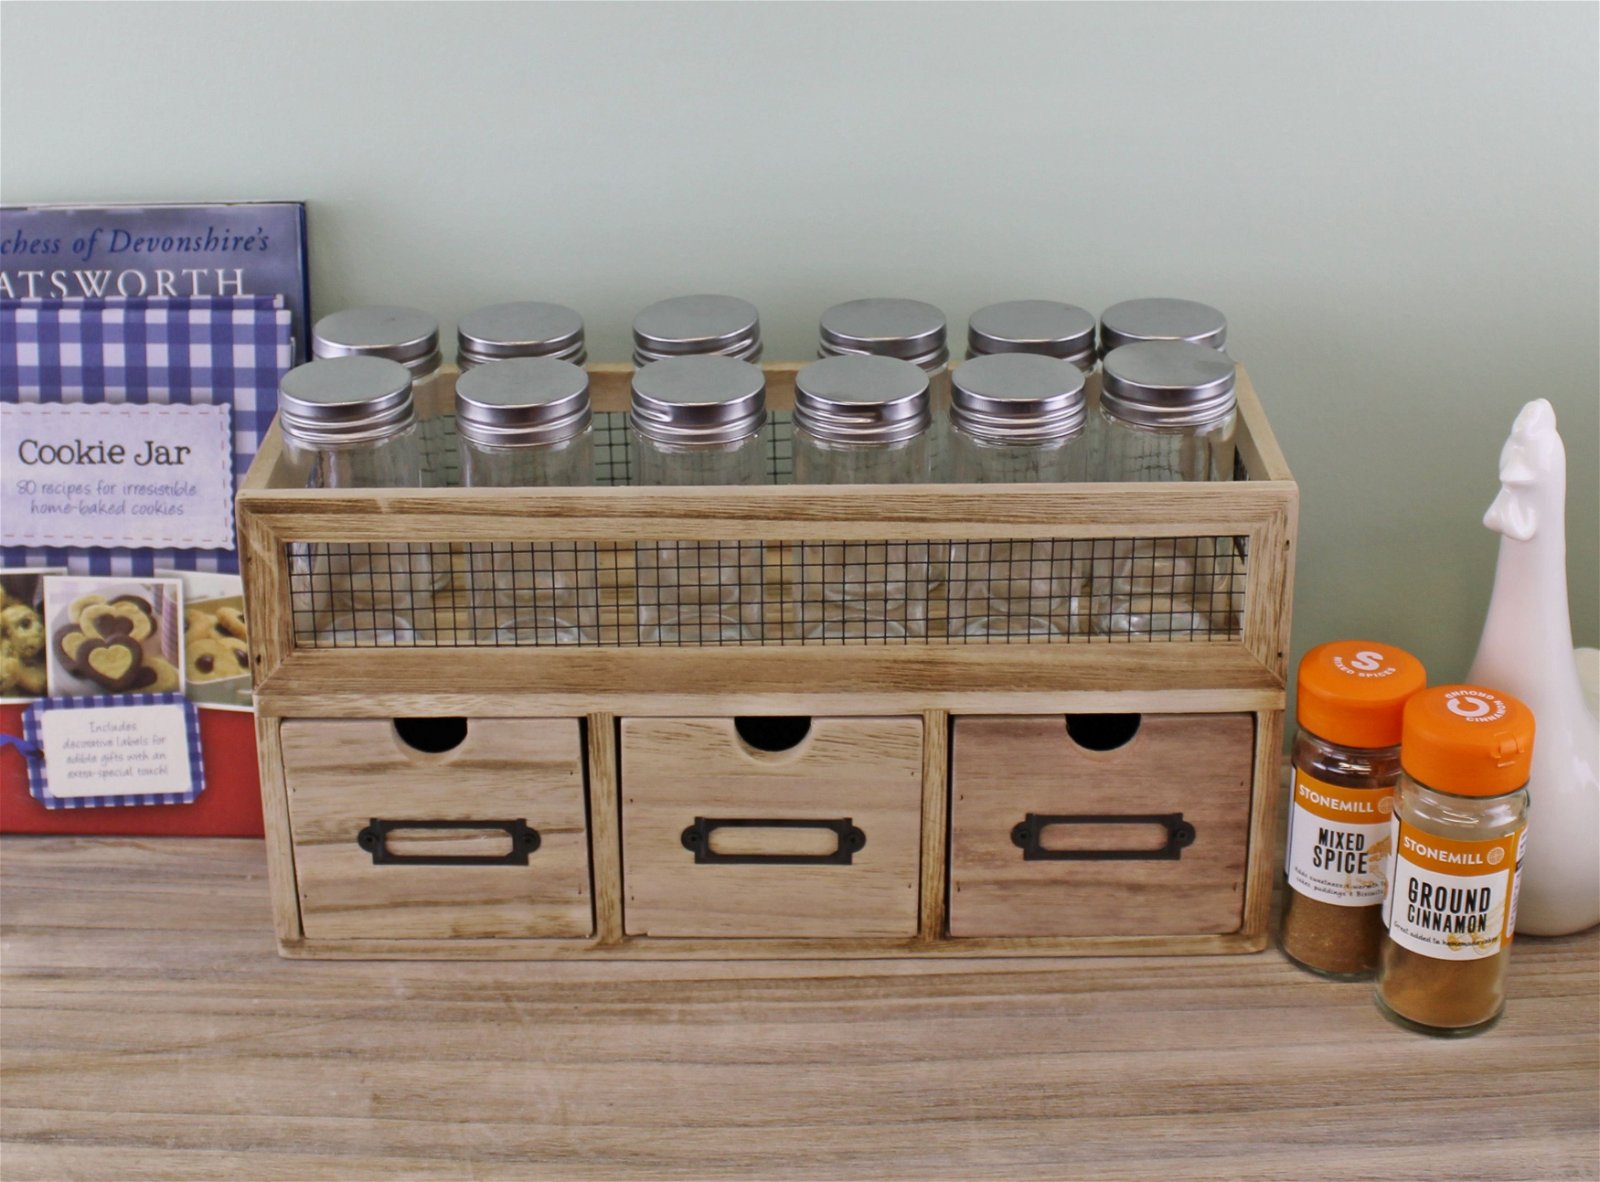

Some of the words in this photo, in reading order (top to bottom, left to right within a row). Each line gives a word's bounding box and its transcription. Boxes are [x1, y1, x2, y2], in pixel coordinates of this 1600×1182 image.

[72, 228, 103, 261] of
[109, 227, 270, 252] Devonshire's
[18, 438, 126, 466] Cookie
[133, 440, 191, 466] Jar
[16, 479, 36, 496] 80
[41, 482, 91, 500] recipes
[96, 480, 115, 496] for
[122, 480, 197, 497] irresistible
[30, 500, 126, 515] home-baked
[131, 500, 184, 515] cookies
[1351, 651, 1384, 671] S
[1447, 696, 1490, 717] C
[88, 721, 138, 734] Includes
[62, 738, 114, 750] decorative
[152, 734, 167, 746] for
[66, 753, 98, 764] edible
[100, 752, 124, 767] gifts
[127, 750, 149, 762] with
[152, 751, 167, 761] an
[1299, 784, 1375, 813] STONEMILL
[1318, 827, 1365, 852] MIXED
[1403, 836, 1484, 865] STONEMILL
[1313, 845, 1369, 874] SPICE
[1408, 877, 1491, 914] GROUND
[1407, 904, 1487, 933] CINNAMON
